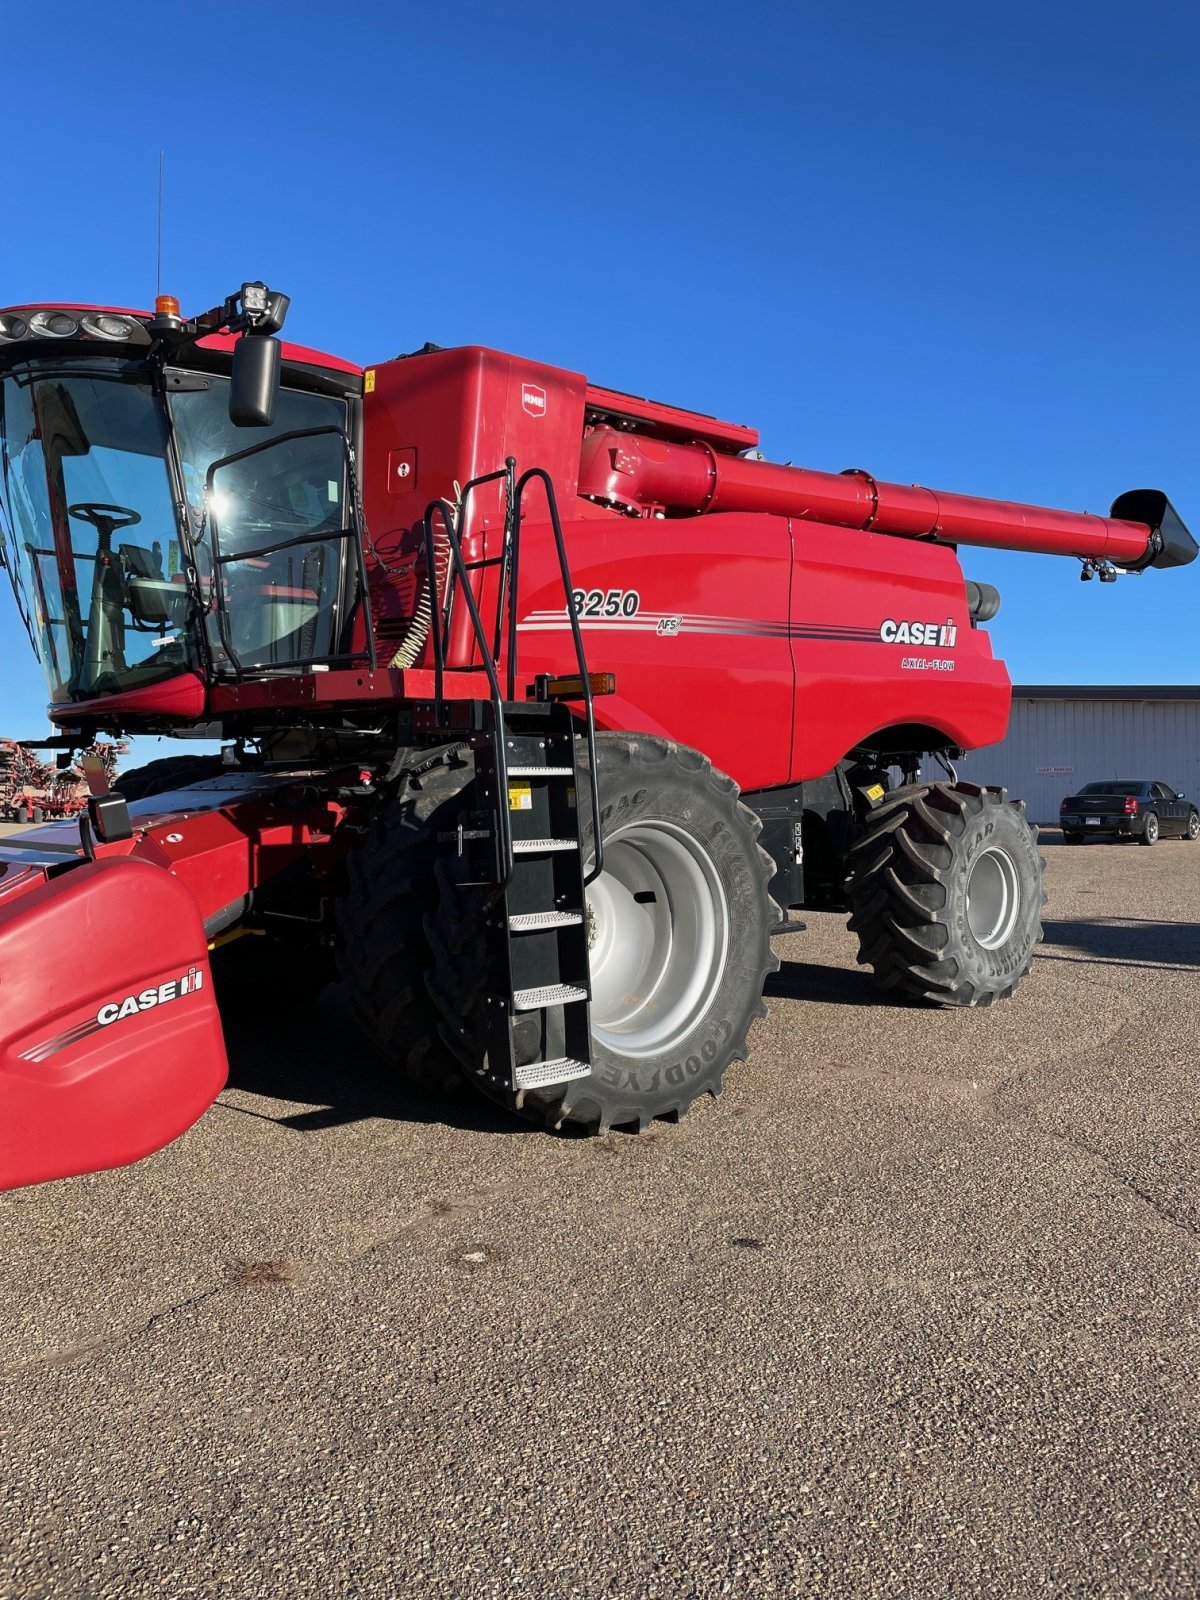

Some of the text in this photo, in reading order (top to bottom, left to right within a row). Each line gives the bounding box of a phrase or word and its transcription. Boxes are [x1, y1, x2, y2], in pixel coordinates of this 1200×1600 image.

[524, 393, 545, 408] RME
[566, 588, 640, 618] 8250
[657, 618, 677, 630] AFS
[880, 618, 938, 646] CASE
[901, 658, 955, 672] AXIAL-FLOW
[97, 979, 177, 1026] CASE
